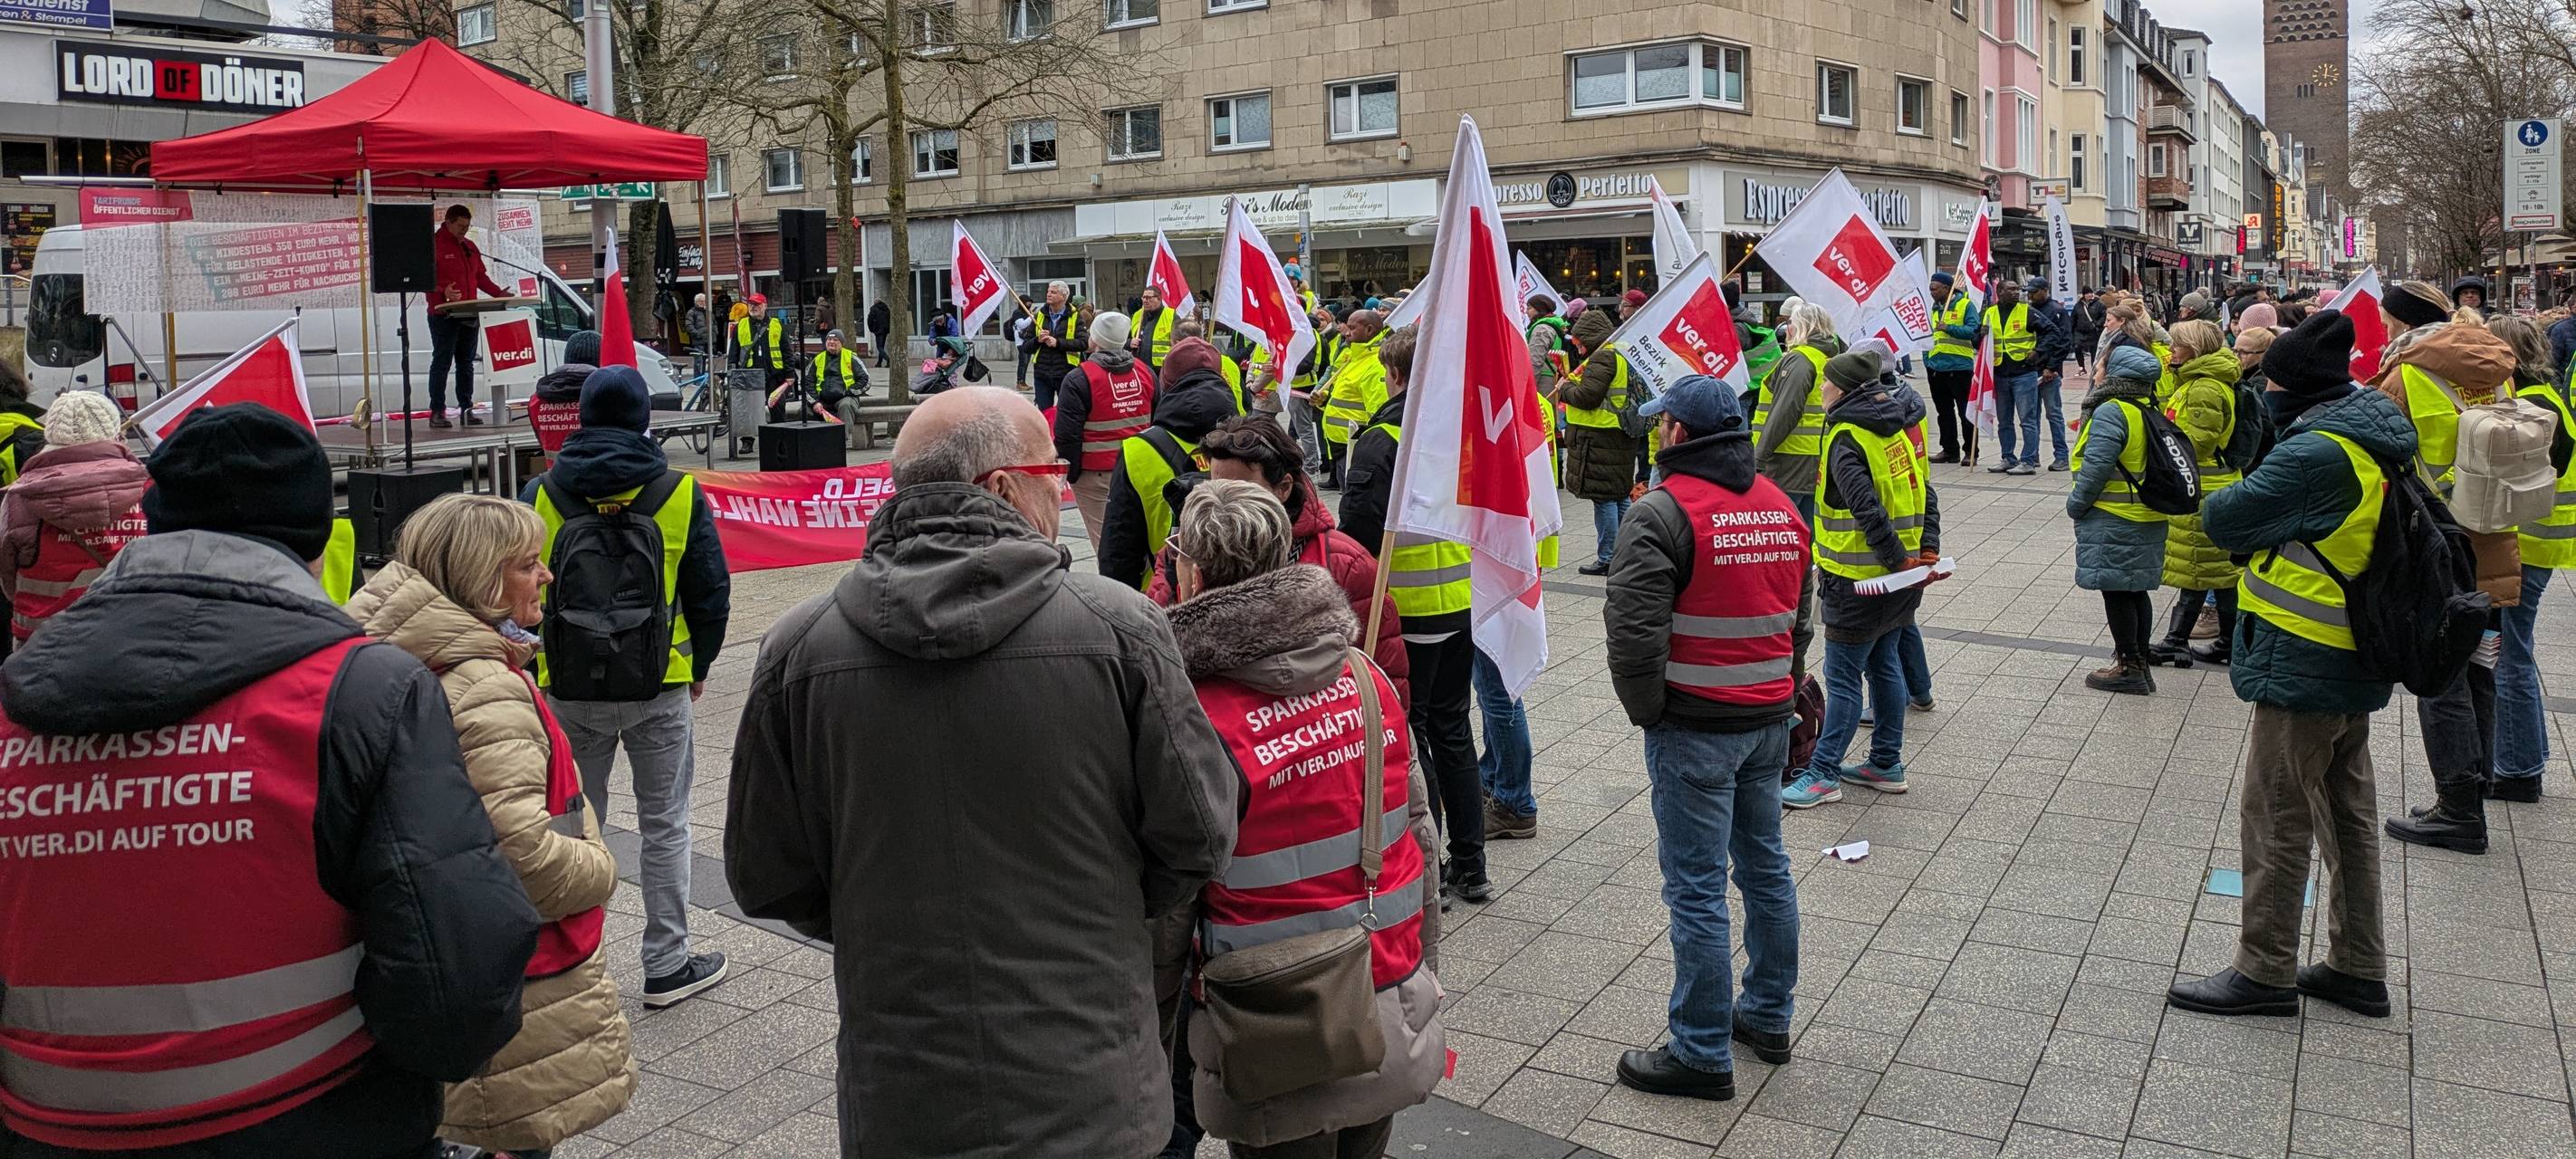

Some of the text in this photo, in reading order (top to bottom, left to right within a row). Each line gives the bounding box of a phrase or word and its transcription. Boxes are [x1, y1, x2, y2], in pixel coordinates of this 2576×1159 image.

[21, 10, 33, 21] &
[34, 12, 88, 24] Stempel
[62, 52, 304, 108] LORD OF DÖNER
[1579, 173, 1653, 199] Perfetto
[93, 204, 180, 216] ÖFFENTLICHER DIENST
[213, 227, 284, 245] BESCHÄFTIGTEN
[216, 242, 273, 259] MINDESTENS
[296, 237, 317, 250] EURO
[206, 260, 223, 273] FÜR
[226, 254, 284, 271] BELASTENDE
[214, 274, 232, 287] EIN
[333, 258, 351, 271] FÜR
[243, 284, 264, 297] EURO
[268, 282, 291, 293] MEHR
[293, 277, 311, 290] FÜR
[1893, 297, 1922, 335] WERT.
[1908, 295, 1929, 333] SIND
[494, 347, 533, 361] ver.di
[1639, 335, 1668, 369] Bezirk
[1676, 317, 1729, 375] ver.di
[1112, 399, 1143, 408] SPARKASSEN
[2162, 436, 2196, 498] adidas
[1712, 511, 1792, 528] SPARKASSEN-
[1714, 529, 1800, 549] BESCHÄFTIGTE
[1714, 551, 1800, 566] MIT VER.DI AUF TOUR
[0, 723, 246, 769] PARKASSEN-
[1269, 766, 1294, 790] MIT
[1295, 751, 1344, 778] VER.DI
[0, 771, 254, 819] SCHÄFTIGTE
[13, 819, 255, 858] VER.DI AUF TOUR
